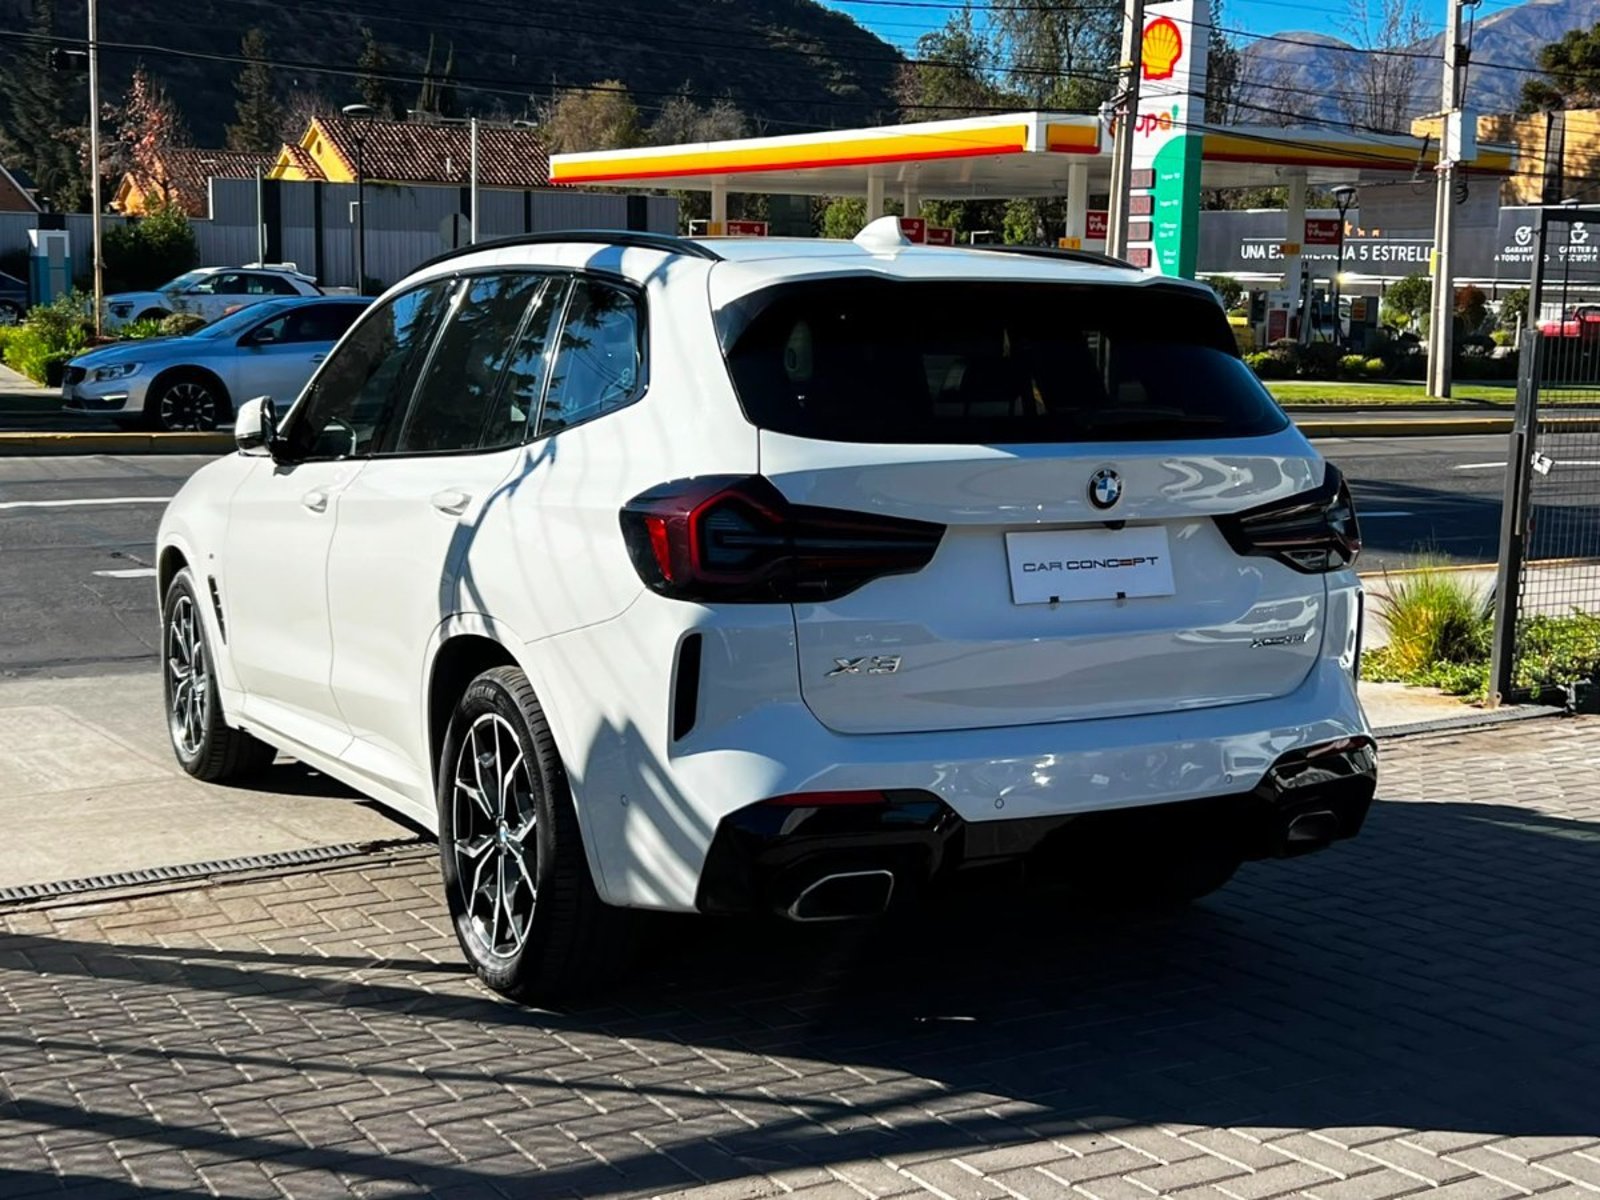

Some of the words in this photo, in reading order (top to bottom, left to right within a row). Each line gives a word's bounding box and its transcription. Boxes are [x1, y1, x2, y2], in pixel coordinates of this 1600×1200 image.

[1240, 244, 1266, 260] UNA
[1359, 245, 1369, 261] 5
[1372, 245, 1432, 262] ESTRELL
[1504, 246, 1534, 254] GARANT
[1022, 562, 1063, 573] CAR
[1066, 556, 1159, 571] CONCEPT
[824, 655, 903, 677] X3
